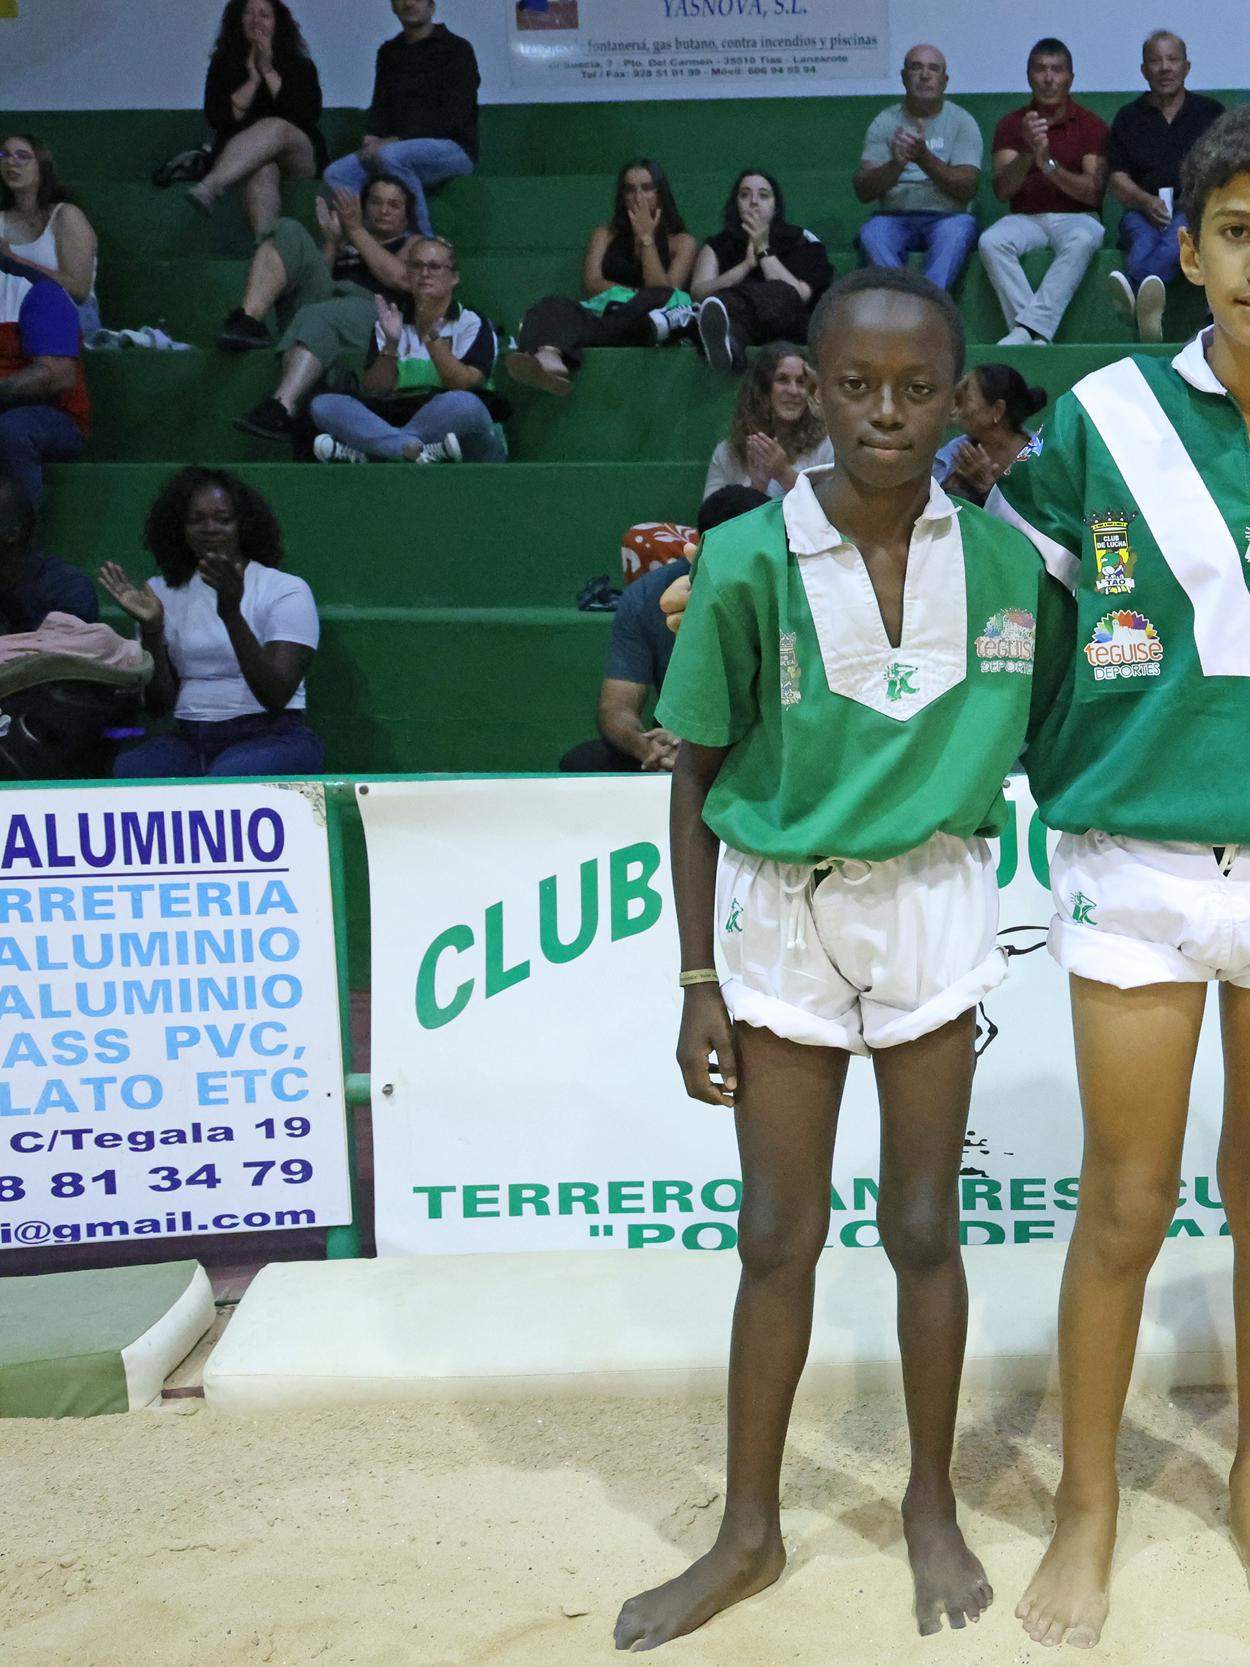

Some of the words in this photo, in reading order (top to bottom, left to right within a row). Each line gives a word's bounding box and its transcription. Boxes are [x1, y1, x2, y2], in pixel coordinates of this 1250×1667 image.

[663, 0, 767, 19] YASNOVA,
[774, 0, 808, 16] S.L.
[653, 40, 672, 54] gas
[675, 36, 718, 50] butano,
[722, 36, 758, 49] contra
[761, 34, 817, 48] incendios
[820, 37, 826, 50] y
[830, 32, 878, 49] piscinas
[1103, 534, 1120, 543] CLUB
[1106, 540, 1127, 548] LUCHA
[1093, 662, 1161, 681] DEPORTES
[2, 807, 285, 869] ALUMINIO
[0, 880, 298, 923] RRETERIA
[0, 926, 300, 972] ALUMINIO
[416, 841, 662, 1030] CLUB
[0, 974, 303, 1020] ALUMINIO
[2, 1029, 130, 1069] ASS
[165, 1021, 306, 1061] PVC,
[0, 1075, 163, 1117] LATO
[196, 1067, 309, 1105] ETC
[9, 1121, 234, 1153] C/Tegala
[255, 1117, 311, 1139] 19
[0, 1175, 26, 1202] 8
[50, 1169, 118, 1198] 81
[148, 1163, 221, 1192] 34
[243, 1159, 313, 1186] 79
[413, 1178, 742, 1219] TERRERO
[831, 1177, 1079, 1211] NRES
[1, 1207, 316, 1245] i@gmail.com
